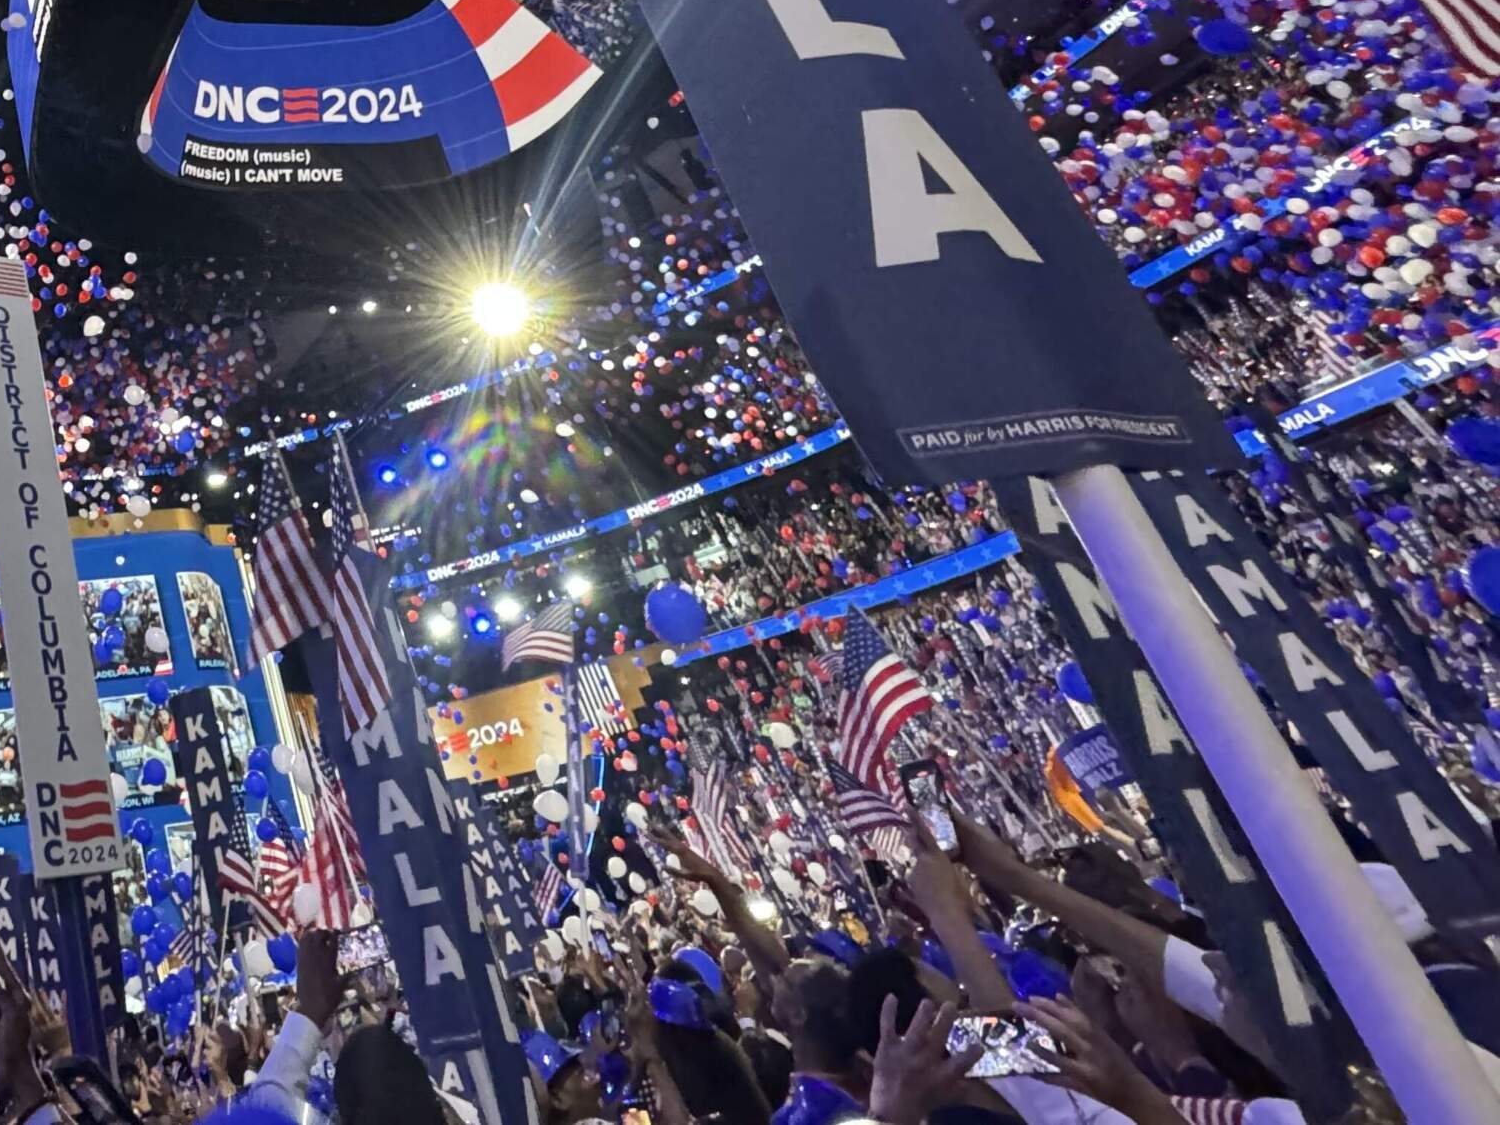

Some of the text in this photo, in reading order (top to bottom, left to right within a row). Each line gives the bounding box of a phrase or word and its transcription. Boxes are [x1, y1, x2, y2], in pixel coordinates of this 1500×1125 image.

[194, 80, 423, 123] DNC 2024
[184, 139, 311, 165] FREEDOM (music)
[180, 160, 343, 185] (music) I CAN'T MOVE
[439, 383, 468, 401] 2024
[911, 430, 961, 449] PAID
[963, 430, 985, 449] for
[1004, 415, 1085, 438] HARRIS
[626, 500, 659, 521] DNC
[669, 483, 705, 505] 2024
[466, 550, 500, 571] 2024
[18, 482, 39, 529] OF
[29, 545, 78, 762] COLUMBIA
[1142, 471, 1472, 862] AMALA
[466, 717, 524, 751] 2024
[7, 813, 21, 823] AZ
[36, 782, 65, 867] DNC
[68, 844, 119, 864] 2024
[351, 711, 466, 986] MALA
[454, 796, 523, 955] KAMALA
